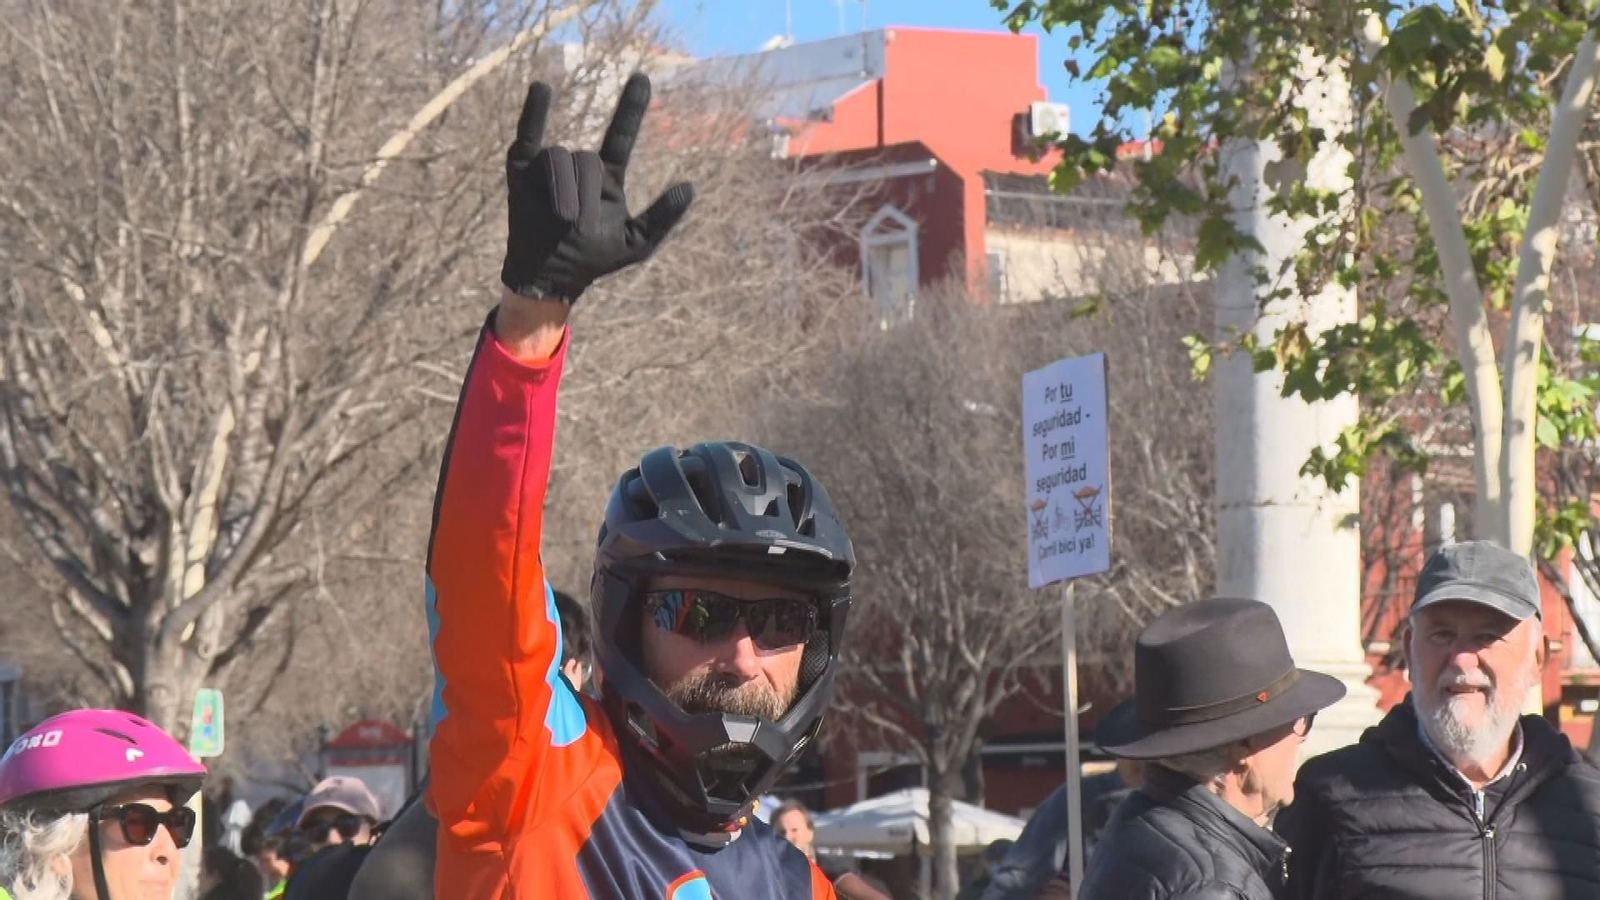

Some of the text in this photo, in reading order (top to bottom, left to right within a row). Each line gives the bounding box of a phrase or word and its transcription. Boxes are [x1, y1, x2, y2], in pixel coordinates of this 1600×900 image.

[1044, 382, 1073, 404] Por tu
[1033, 406, 1081, 438] seguridad
[1042, 436, 1075, 462] Por mi
[1036, 462, 1087, 494] seguridad
[1059, 536, 1076, 554] bici
